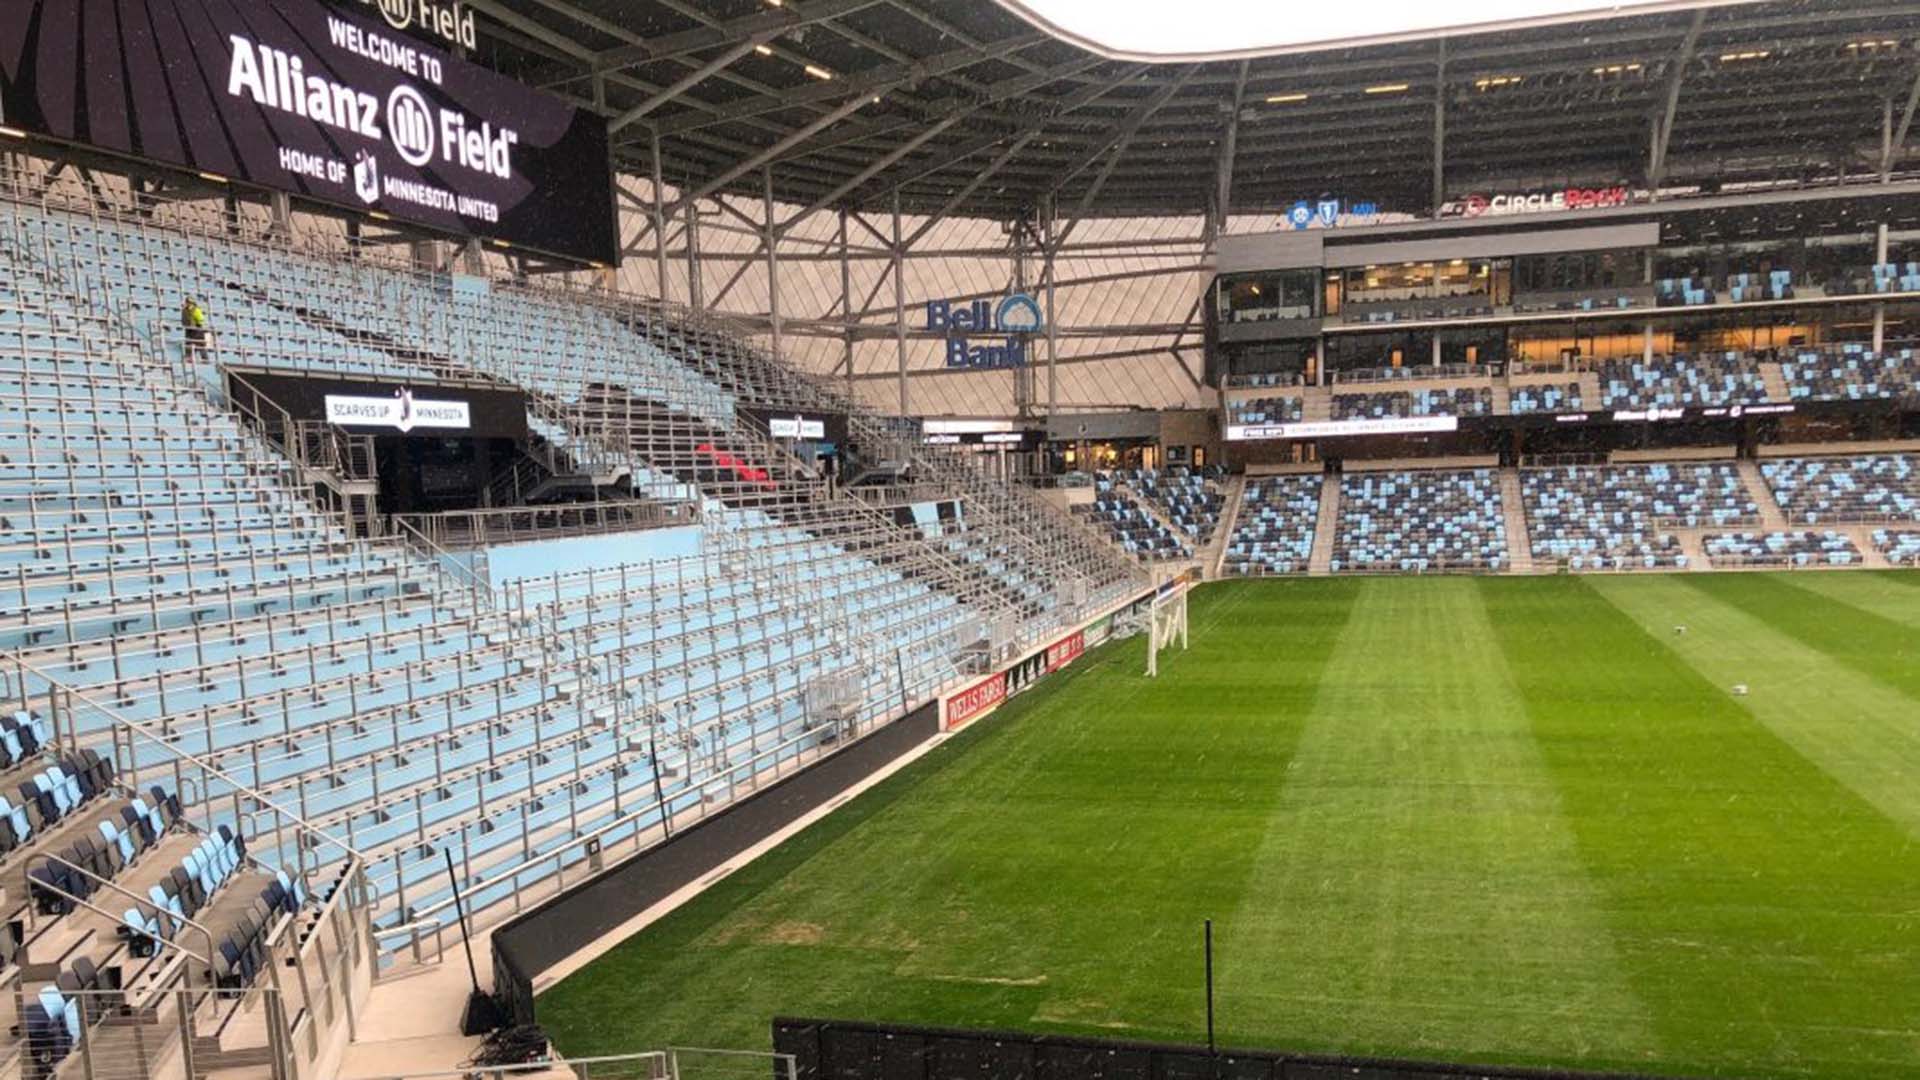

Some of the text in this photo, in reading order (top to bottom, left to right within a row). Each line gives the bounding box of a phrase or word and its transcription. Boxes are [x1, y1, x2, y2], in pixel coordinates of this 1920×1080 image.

[327, 16, 443, 84] WELCOME TO
[419, 0, 476, 50] Field
[228, 34, 381, 140] Allianz
[279, 147, 499, 223] HOME OF MINNESOTA UNITED
[927, 300, 991, 331] Bell
[946, 334, 1025, 369] Bank
[333, 403, 463, 420] SCARVES UP MINNESOTA
